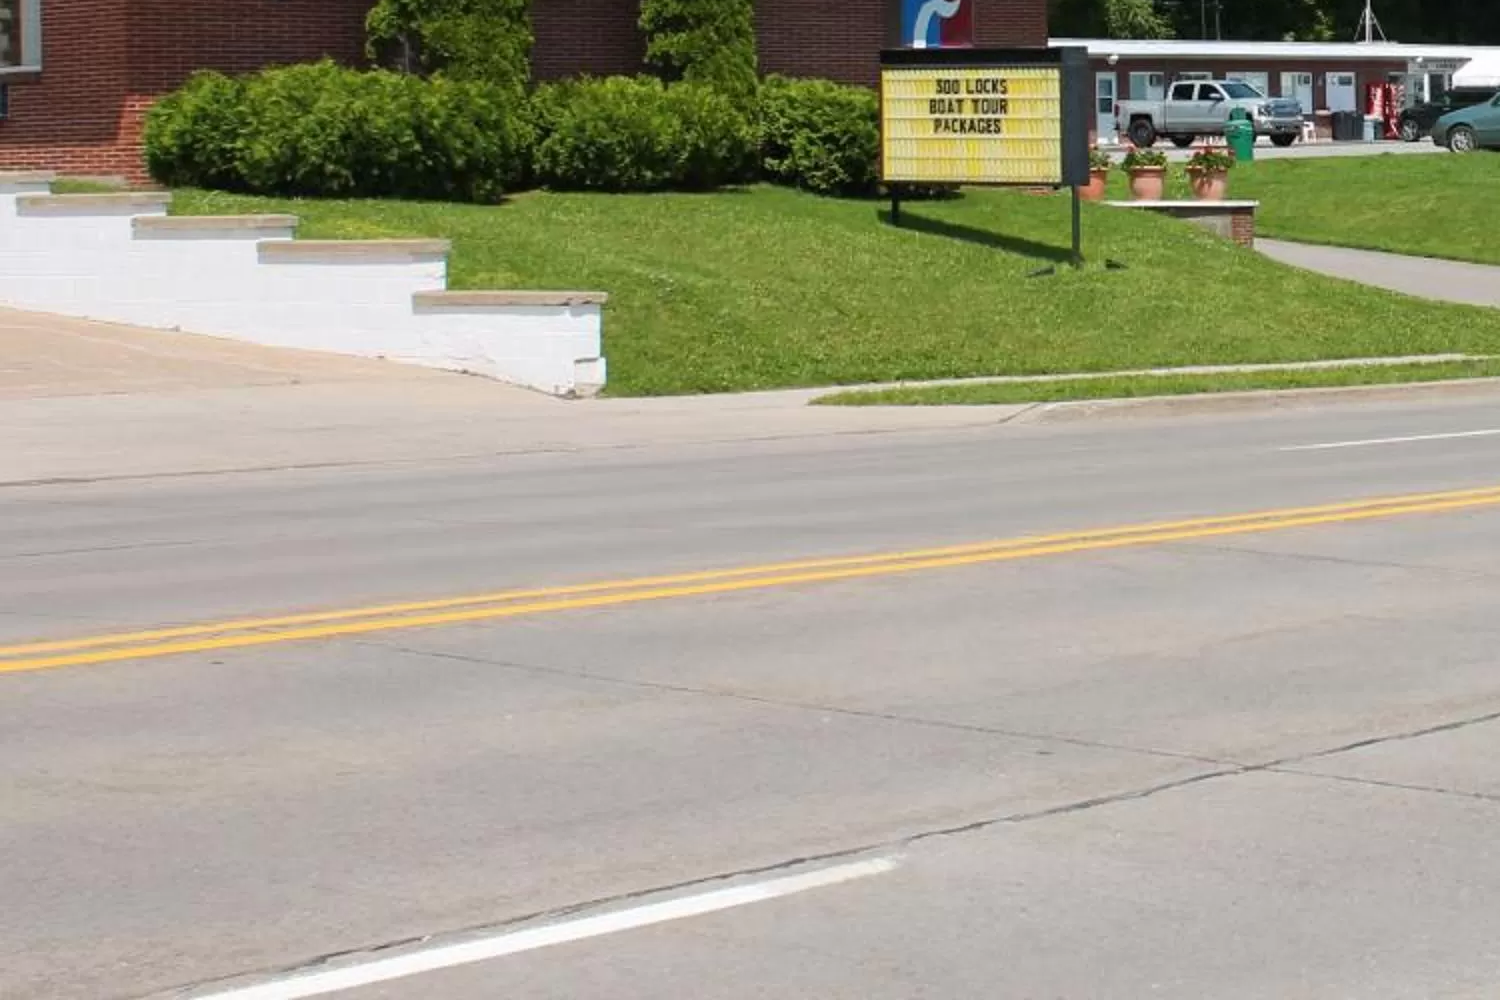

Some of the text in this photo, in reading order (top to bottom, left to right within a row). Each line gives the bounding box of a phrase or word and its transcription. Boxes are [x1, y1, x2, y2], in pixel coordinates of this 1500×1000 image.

[936, 79, 1008, 94] SOO LOCKS
[929, 99, 1008, 115] BOAT TOUR
[933, 118, 1001, 134] PACKAGES
